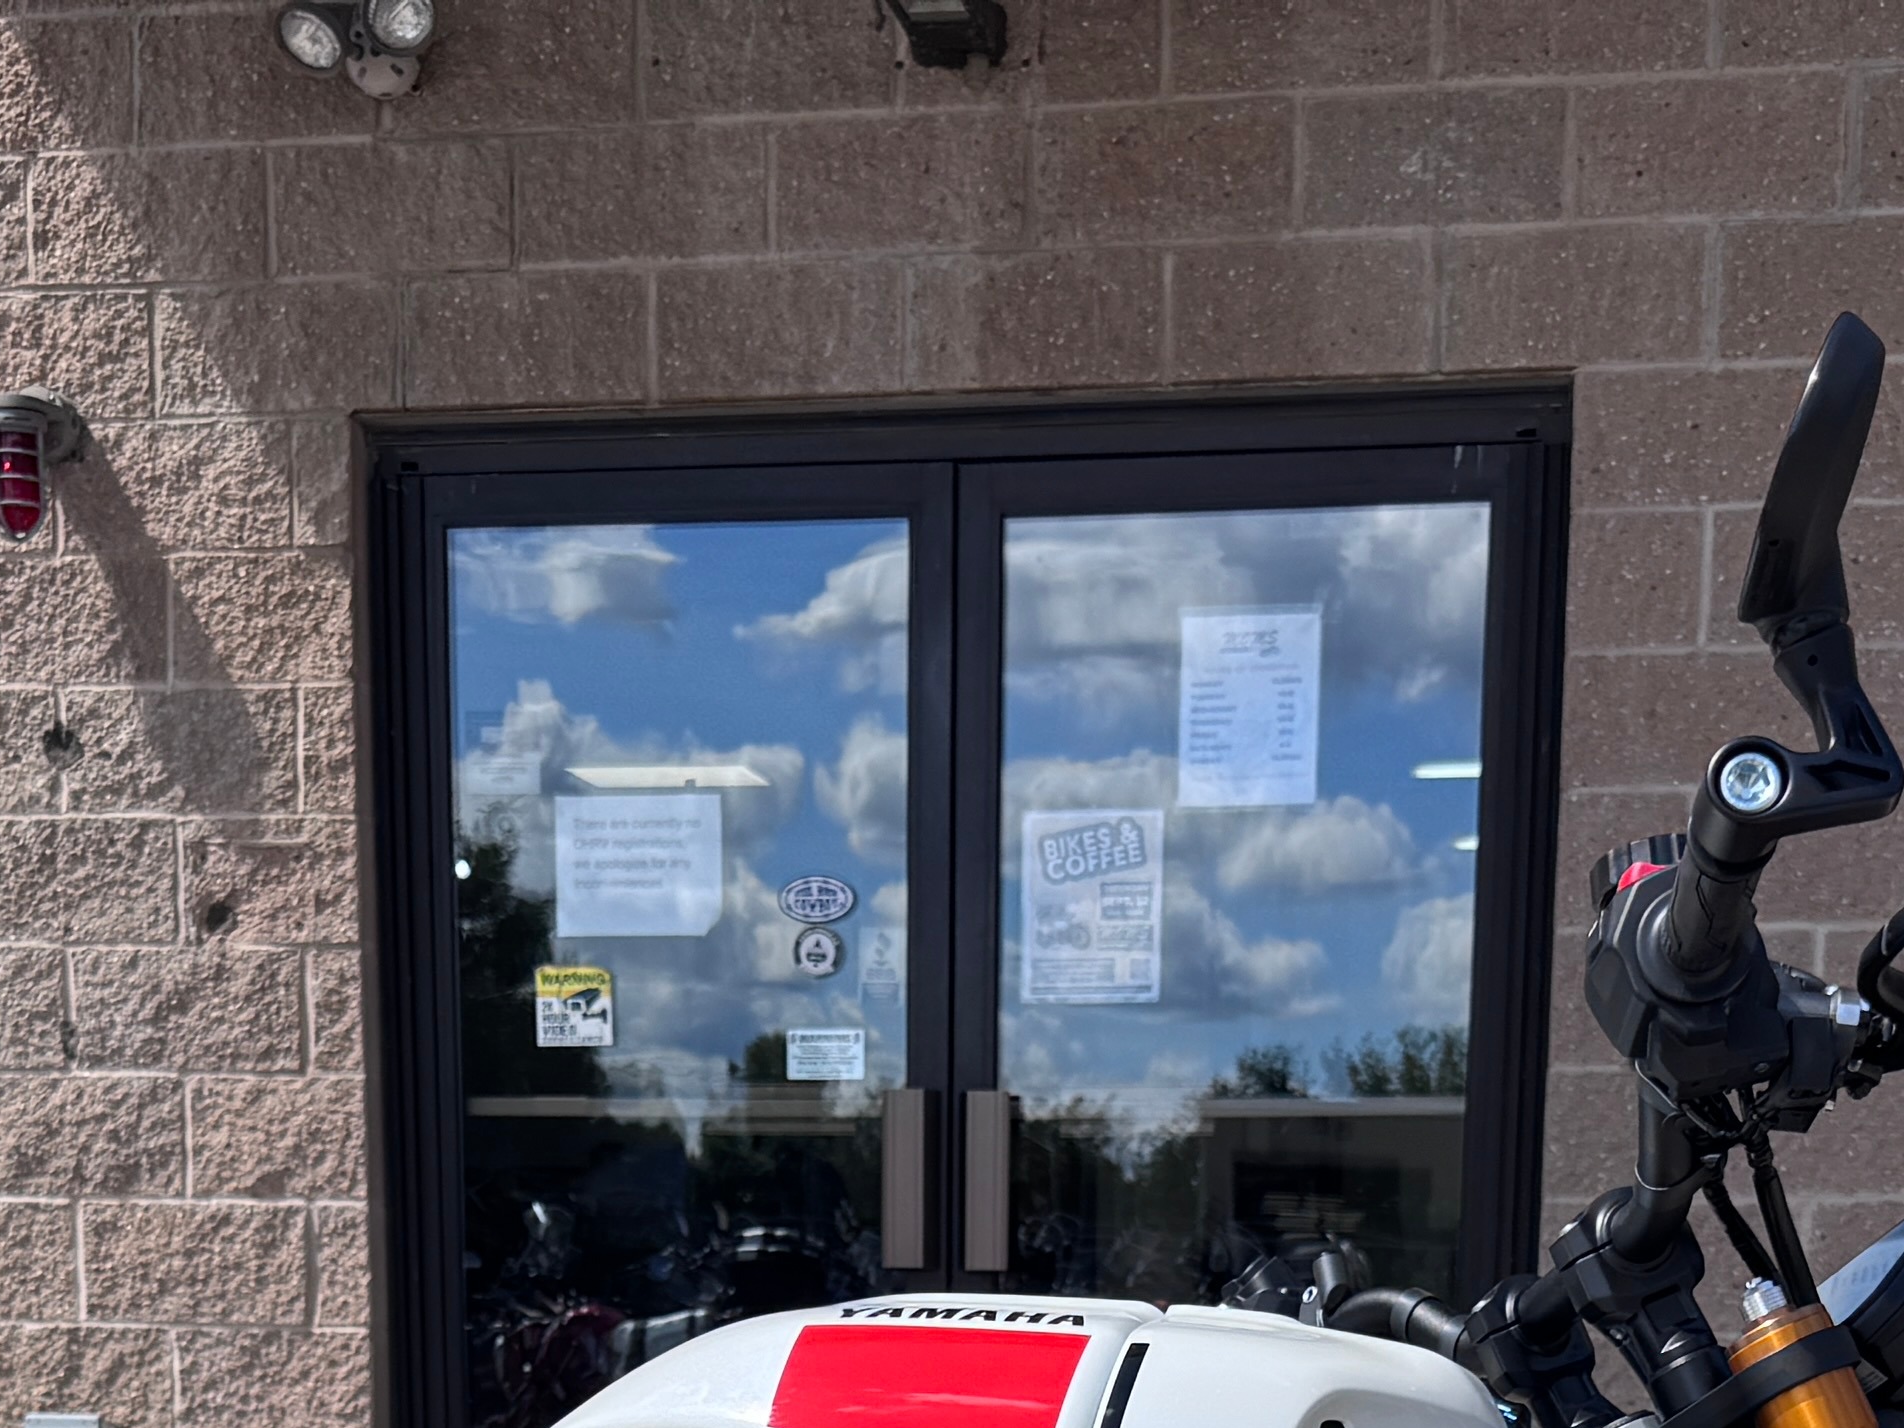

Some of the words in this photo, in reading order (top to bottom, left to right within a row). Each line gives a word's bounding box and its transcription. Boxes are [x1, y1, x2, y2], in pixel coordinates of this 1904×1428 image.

[1042, 827, 1112, 861] BIKES
[1119, 822, 1139, 845] &
[1047, 842, 1143, 880] COFFEE
[540, 972, 607, 987] WARNING
[838, 1306, 1086, 1327] YAMAHA
